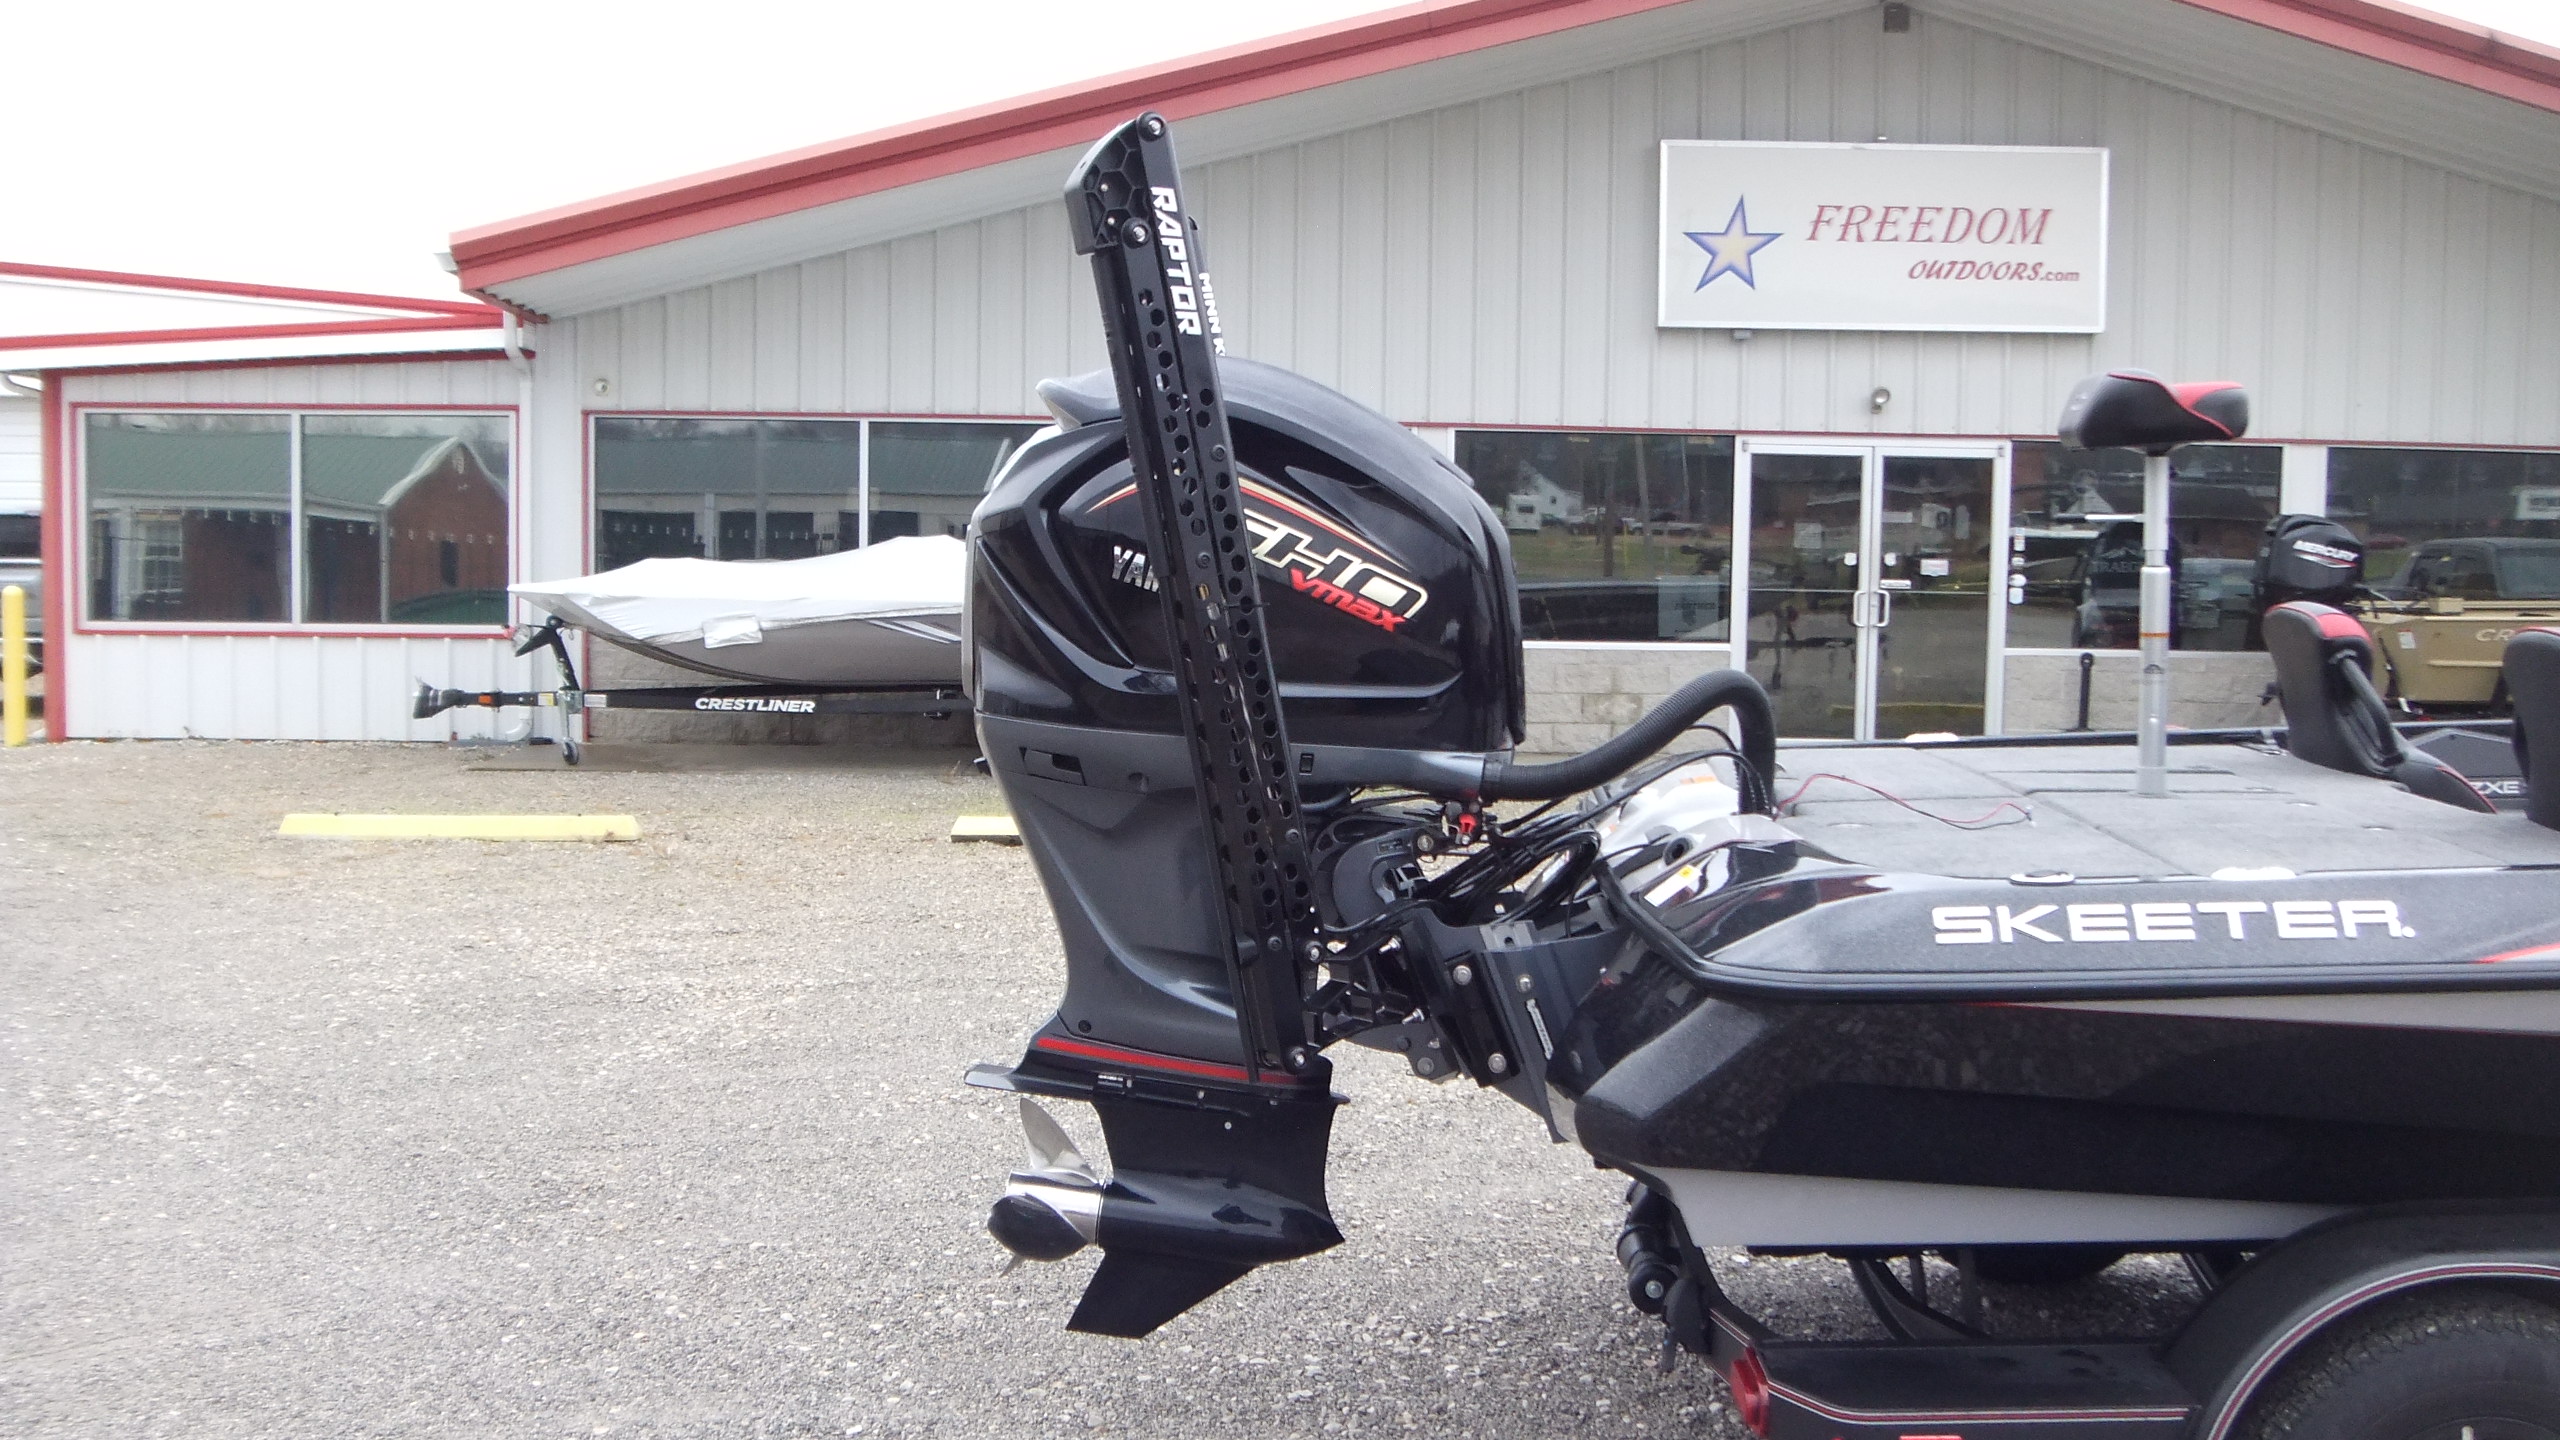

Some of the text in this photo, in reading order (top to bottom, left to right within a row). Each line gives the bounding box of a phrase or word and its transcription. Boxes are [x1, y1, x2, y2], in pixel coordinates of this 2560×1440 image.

[1806, 203, 2054, 246] FREEDOM
[1150, 186, 1202, 336] RAPTOR
[1907, 259, 2081, 282] OUTDOORS.com
[1198, 272, 1222, 334] MINN
[695, 697, 816, 714] CRESTLINER
[1931, 899, 2403, 944] SKEETER
